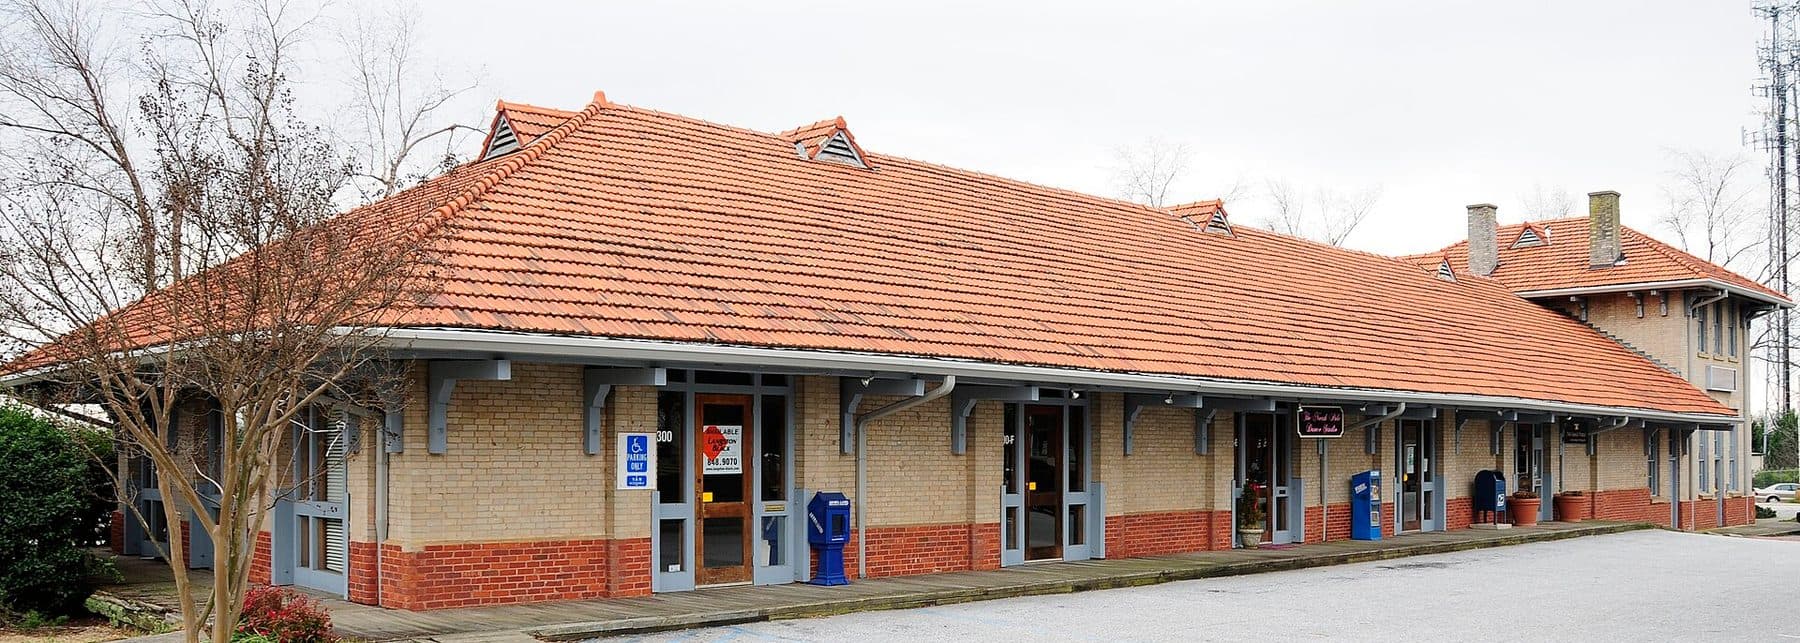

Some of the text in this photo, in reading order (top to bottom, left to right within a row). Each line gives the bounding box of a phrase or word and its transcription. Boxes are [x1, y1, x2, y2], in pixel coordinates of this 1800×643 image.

[656, 430, 673, 442] 300
[627, 453, 648, 461] PARKING
[631, 462, 644, 470] ONLY
